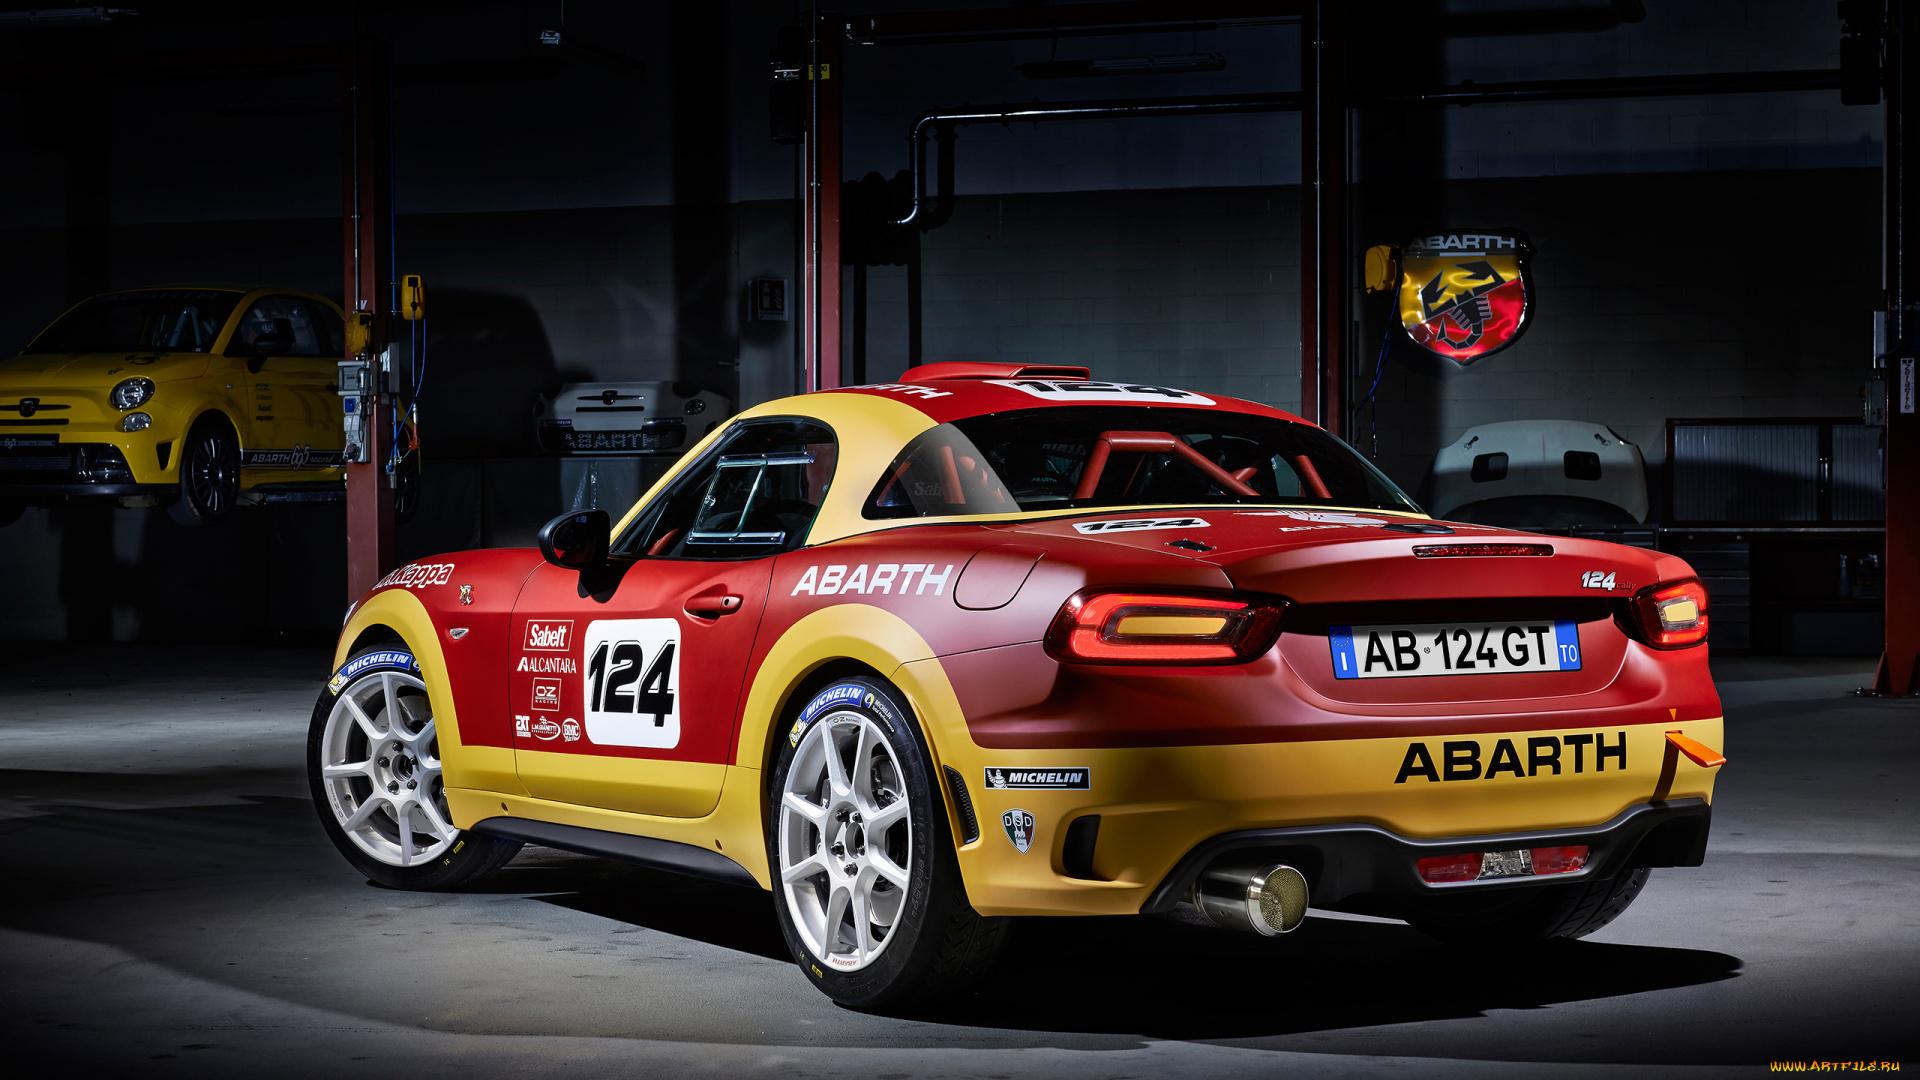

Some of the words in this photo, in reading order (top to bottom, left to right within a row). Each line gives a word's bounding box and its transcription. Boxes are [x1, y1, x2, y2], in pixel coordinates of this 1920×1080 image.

[1409, 234, 1516, 250] ABARTH
[1010, 379, 1193, 398] 124
[251, 453, 291, 463] ABARTH
[291, 444, 311, 470] 695
[913, 480, 943, 497] Sab
[1082, 518, 1202, 532] 124
[790, 563, 955, 597] ABARTH
[1581, 571, 1617, 591] 124
[1616, 581, 1637, 592] rally
[529, 623, 567, 648] Sabelt
[1340, 652, 1348, 672] I
[1364, 630, 1422, 673] AB
[1560, 643, 1578, 664] TO
[347, 652, 409, 676] MICHELIN
[528, 657, 577, 674] ALCANTARA
[536, 685, 557, 697] OZ
[587, 639, 676, 728] 124
[805, 686, 862, 719] MICHELIN
[874, 699, 893, 720] MICHELIN
[1394, 731, 1627, 784] ABARTH
[1008, 772, 1083, 783] MICHELIN
[1004, 815, 1032, 828] DSD
[832, 956, 857, 967] ABARTH
